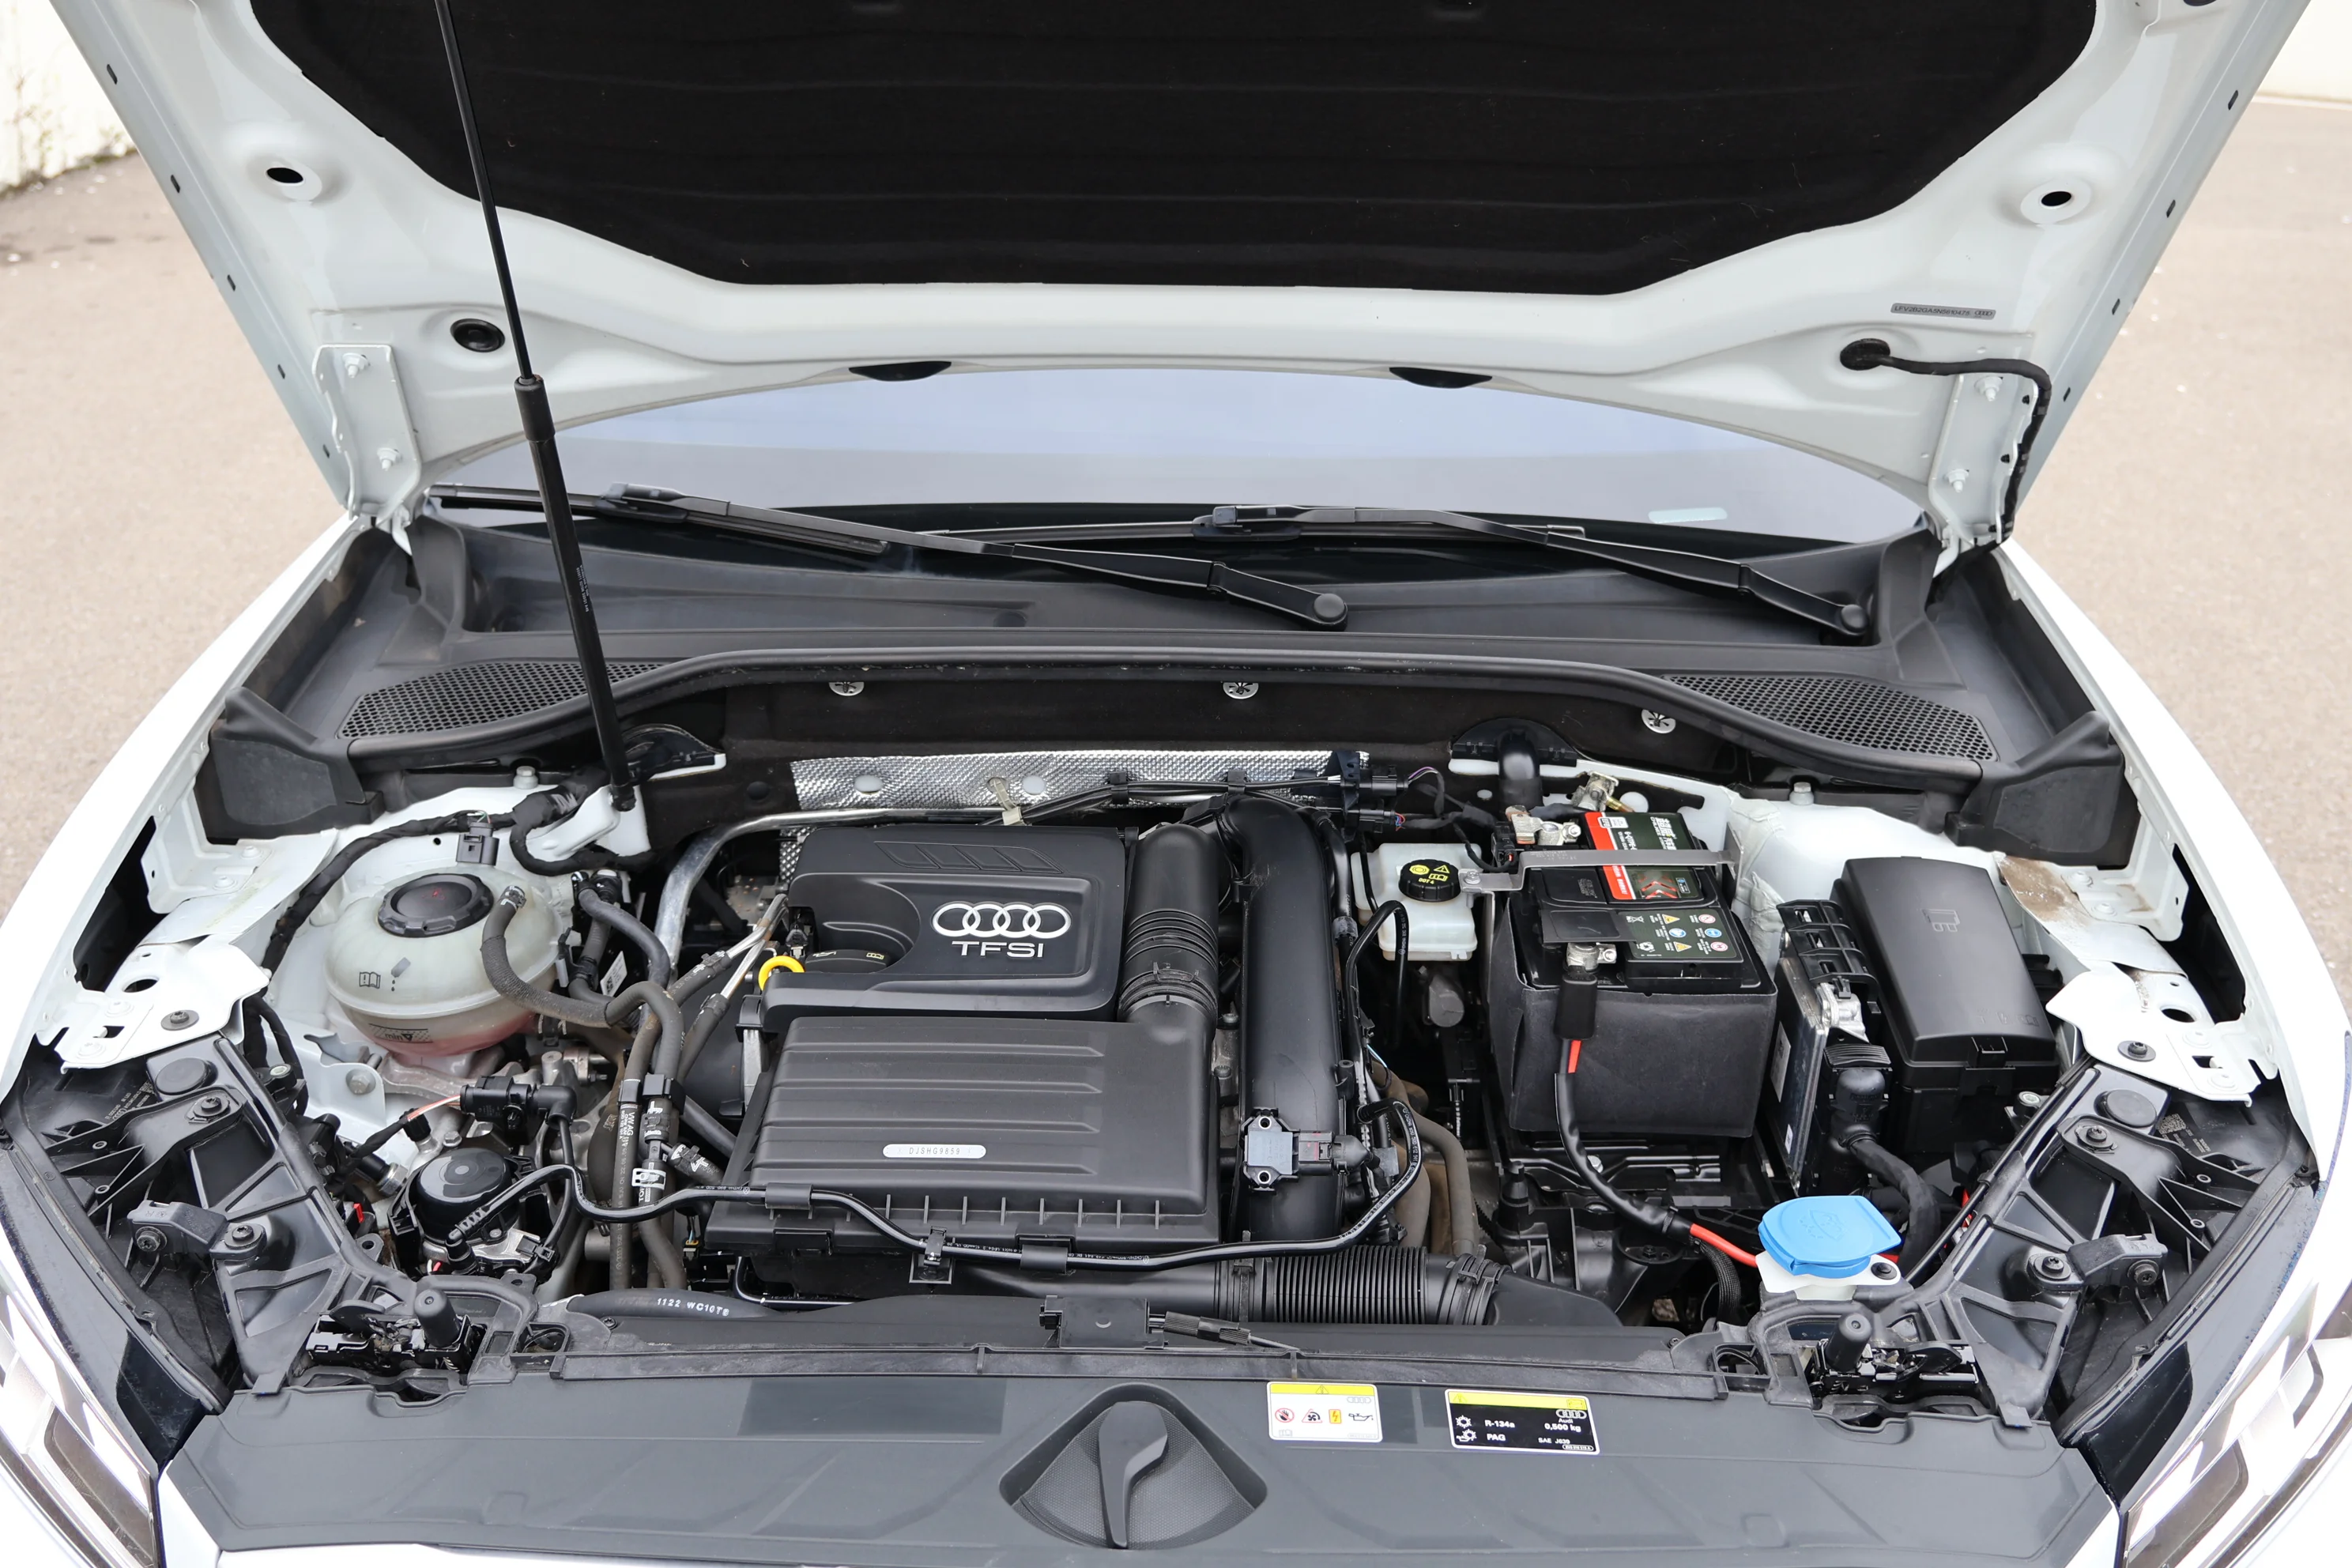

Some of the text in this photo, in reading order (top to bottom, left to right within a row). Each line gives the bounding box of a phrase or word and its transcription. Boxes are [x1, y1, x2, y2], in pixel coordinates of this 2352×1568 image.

[952, 940, 1043, 957] TFSI
[384, 1032, 403, 1041] min
[627, 1112, 635, 1136] VW AG
[657, 1298, 681, 1308] 1122
[1484, 1419, 1515, 1428] R-134a
[1544, 1423, 1569, 1431] 0,500
